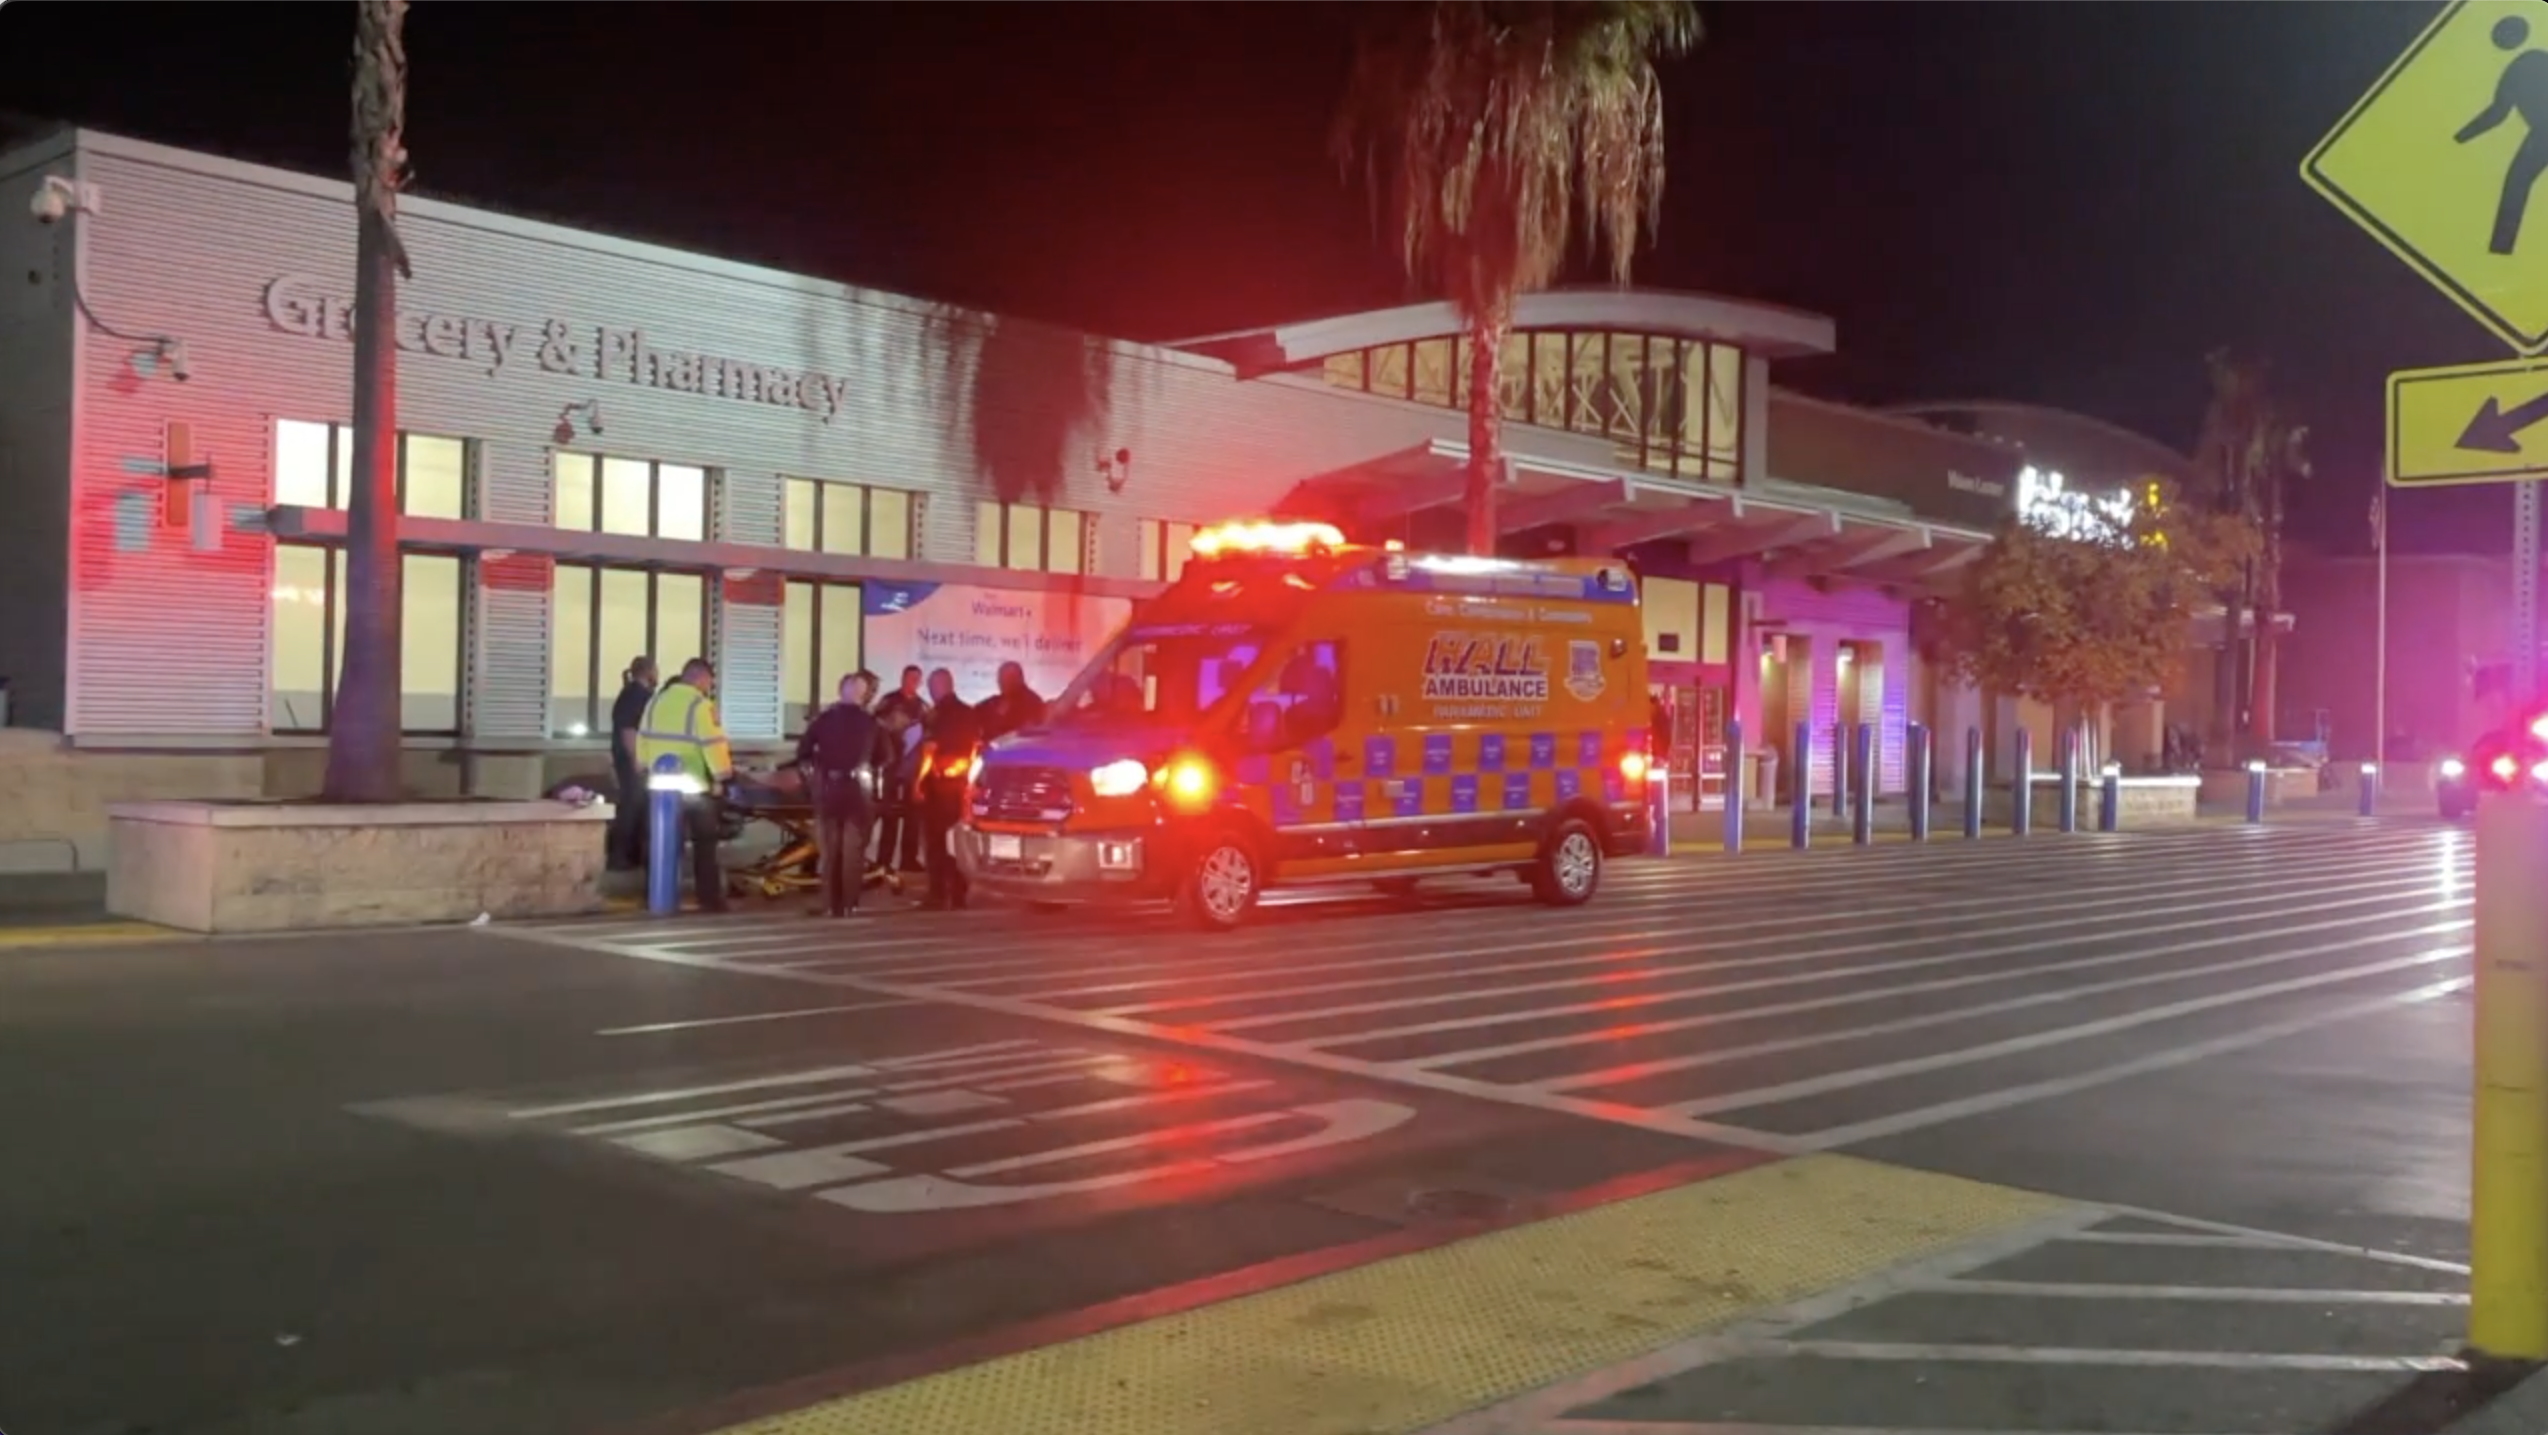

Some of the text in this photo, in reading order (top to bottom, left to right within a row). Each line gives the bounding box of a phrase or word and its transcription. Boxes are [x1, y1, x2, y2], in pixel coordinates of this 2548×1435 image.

[264, 272, 849, 423] Grcery & Pharmacy
[917, 628, 955, 647] Next
[1425, 678, 1547, 698] AMBULANCE
